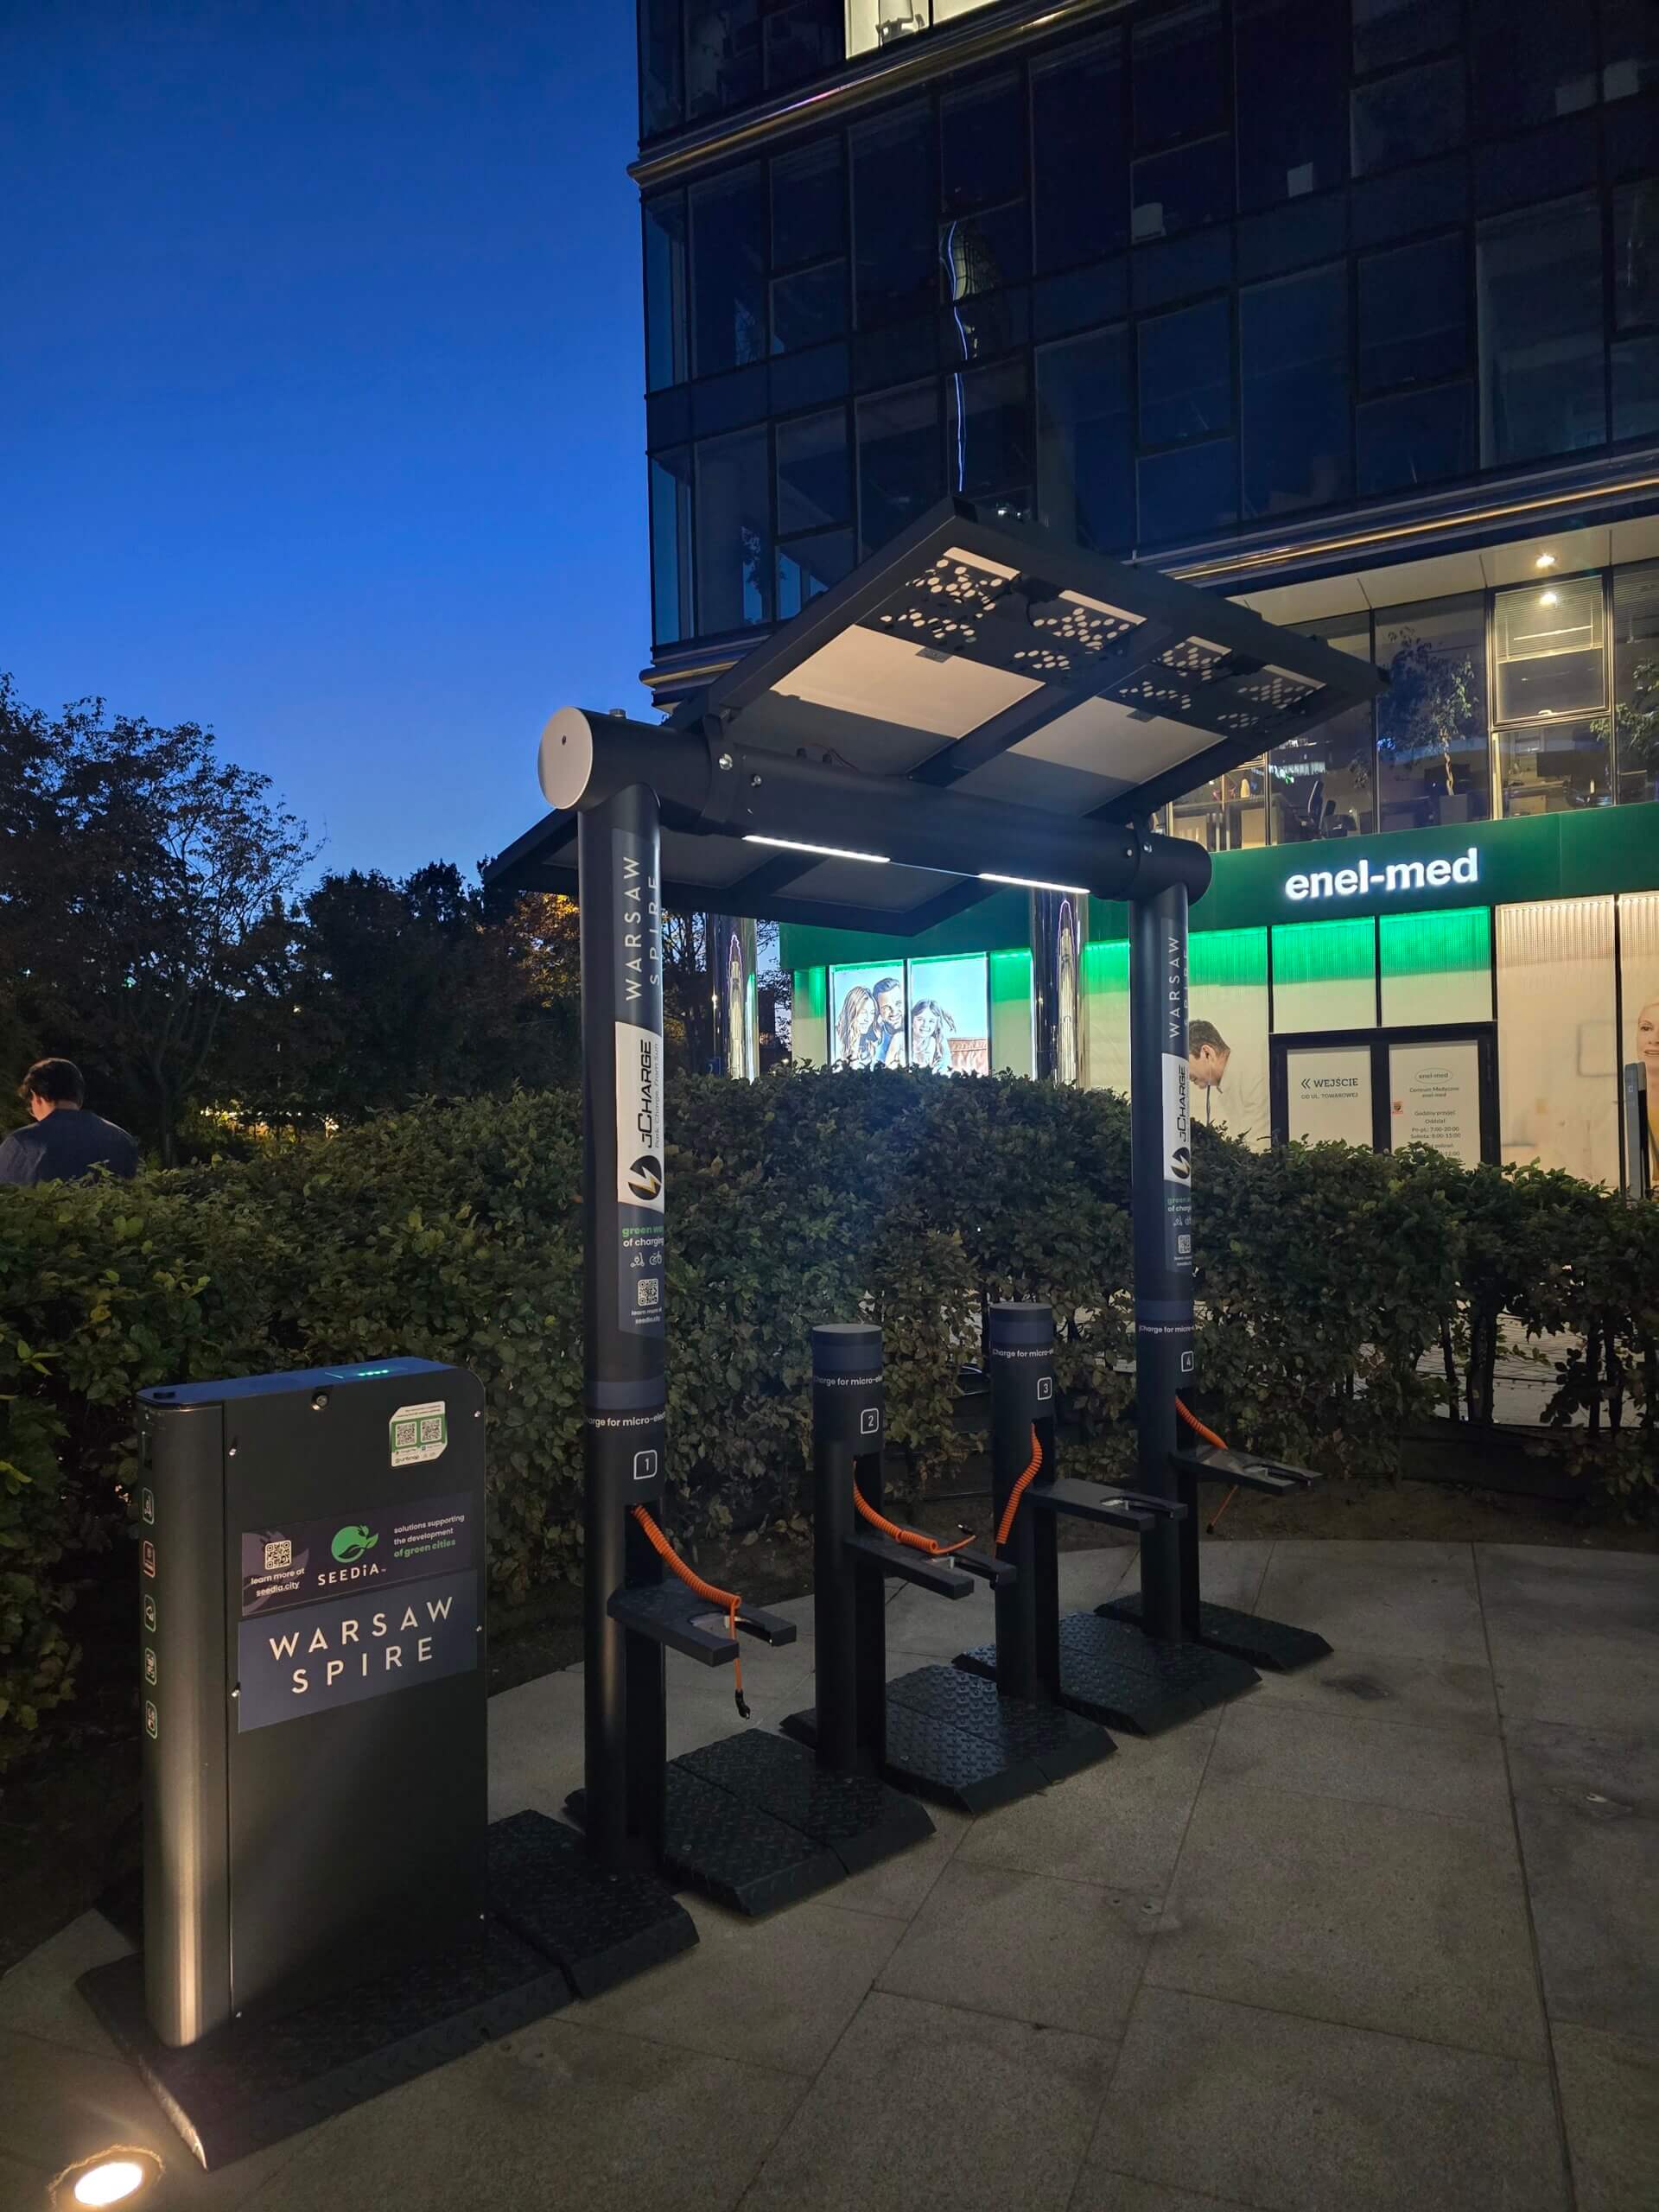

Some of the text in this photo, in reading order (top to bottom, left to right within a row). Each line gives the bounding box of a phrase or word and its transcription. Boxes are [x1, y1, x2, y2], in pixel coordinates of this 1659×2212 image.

[1285, 847, 1479, 900] enel-med
[623, 856, 643, 1001] WARSAW
[1168, 938, 1180, 1038] WARSAW
[623, 1237, 633, 1248] of
[837, 1377, 849, 1386] for
[1043, 1382, 1049, 1394] 3
[607, 1417, 620, 1427] for
[868, 1415, 874, 1427] 2
[645, 1458, 650, 1471] 1
[393, 1514, 465, 1534] solutions supporting
[393, 1528, 454, 1546] the development
[393, 1538, 456, 1558] of green cities
[251, 1575, 272, 1585] learn
[273, 1571, 296, 1580] more
[269, 1597, 453, 1661] WARSAW
[291, 1637, 433, 1694] SPIRE
